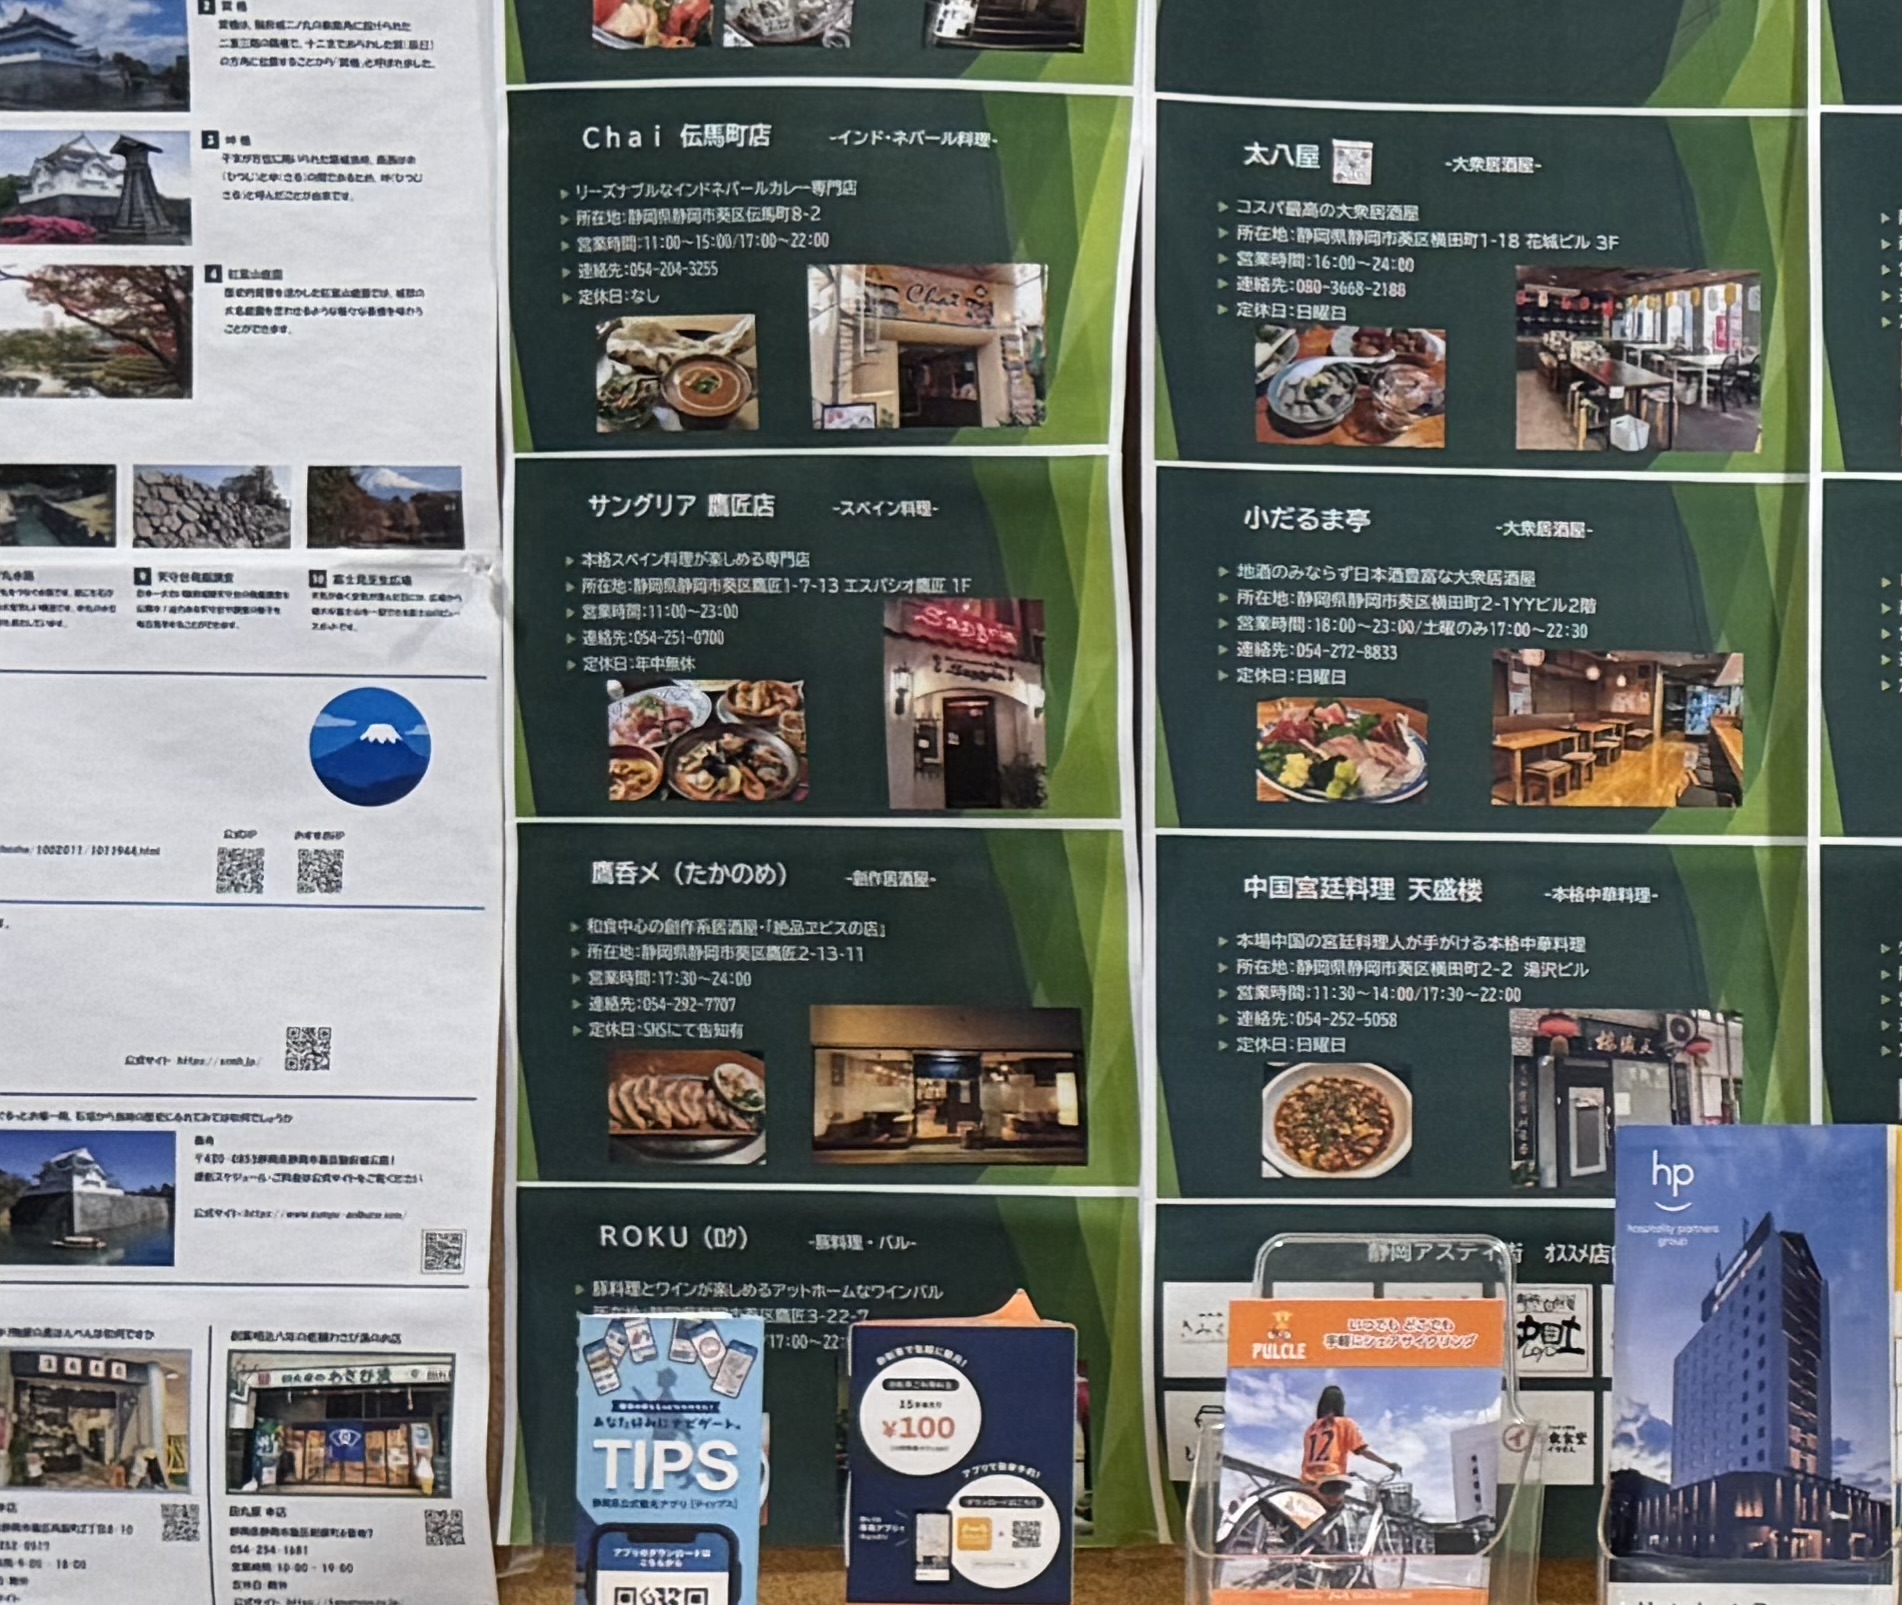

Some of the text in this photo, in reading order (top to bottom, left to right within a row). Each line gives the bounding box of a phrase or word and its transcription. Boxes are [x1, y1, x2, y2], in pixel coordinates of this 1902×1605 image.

[583, 124, 771, 148] Chai 伝馬町店
[1243, 143, 1320, 169] 太八屋
[589, 494, 775, 518] サングリア 鷹匠店
[1243, 507, 1372, 533] 小だるま亭
[1243, 877, 1483, 903] 中国宮廷料理 天盛楼
[1652, 1149, 1695, 1198] hp
[600, 1226, 688, 1246] ROKU
[1252, 1342, 1306, 1360] PULCLE
[1308, 1431, 1335, 1463] 12
[593, 1439, 739, 1491] TIPS
